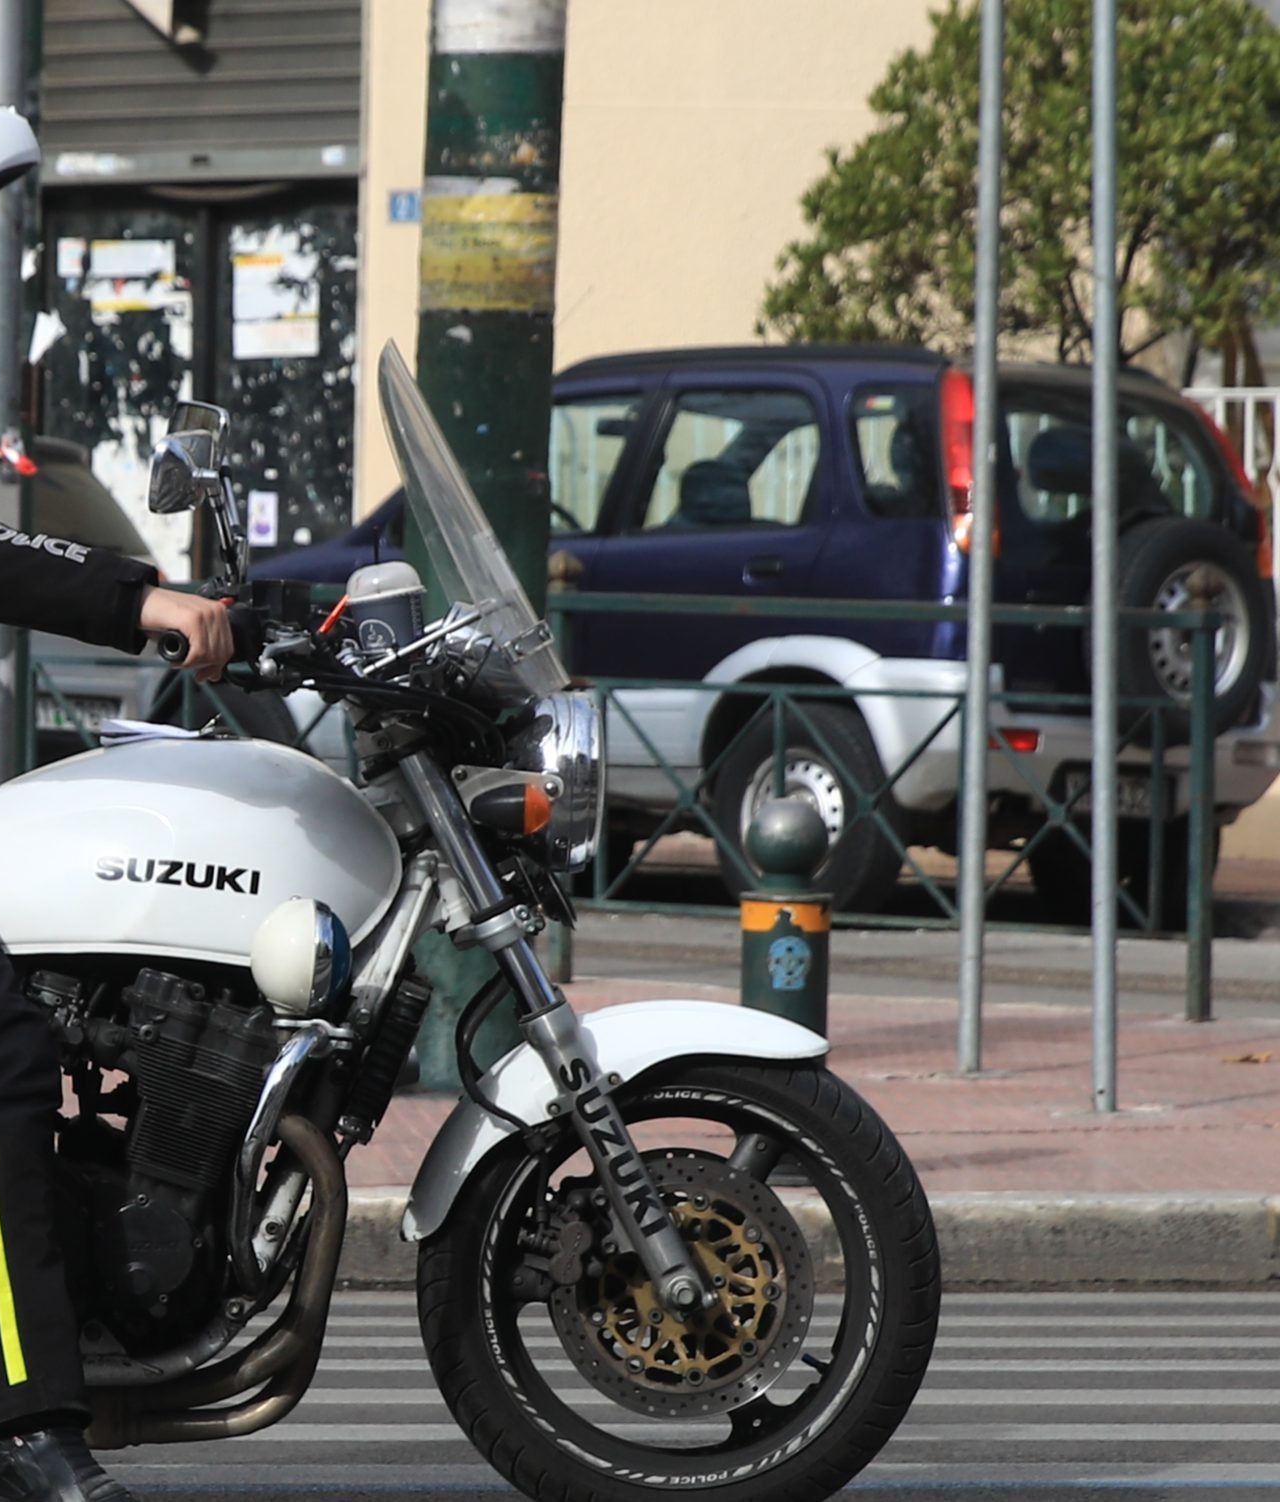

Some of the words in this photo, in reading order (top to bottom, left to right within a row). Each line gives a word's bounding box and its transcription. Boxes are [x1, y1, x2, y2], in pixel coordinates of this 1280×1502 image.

[96, 856, 261, 895] SUZUKI
[559, 1057, 669, 1238] SUZUKI
[853, 1203, 878, 1259] POLICE
[484, 1308, 506, 1365] POLICE
[669, 1470, 728, 1485] POLICE
